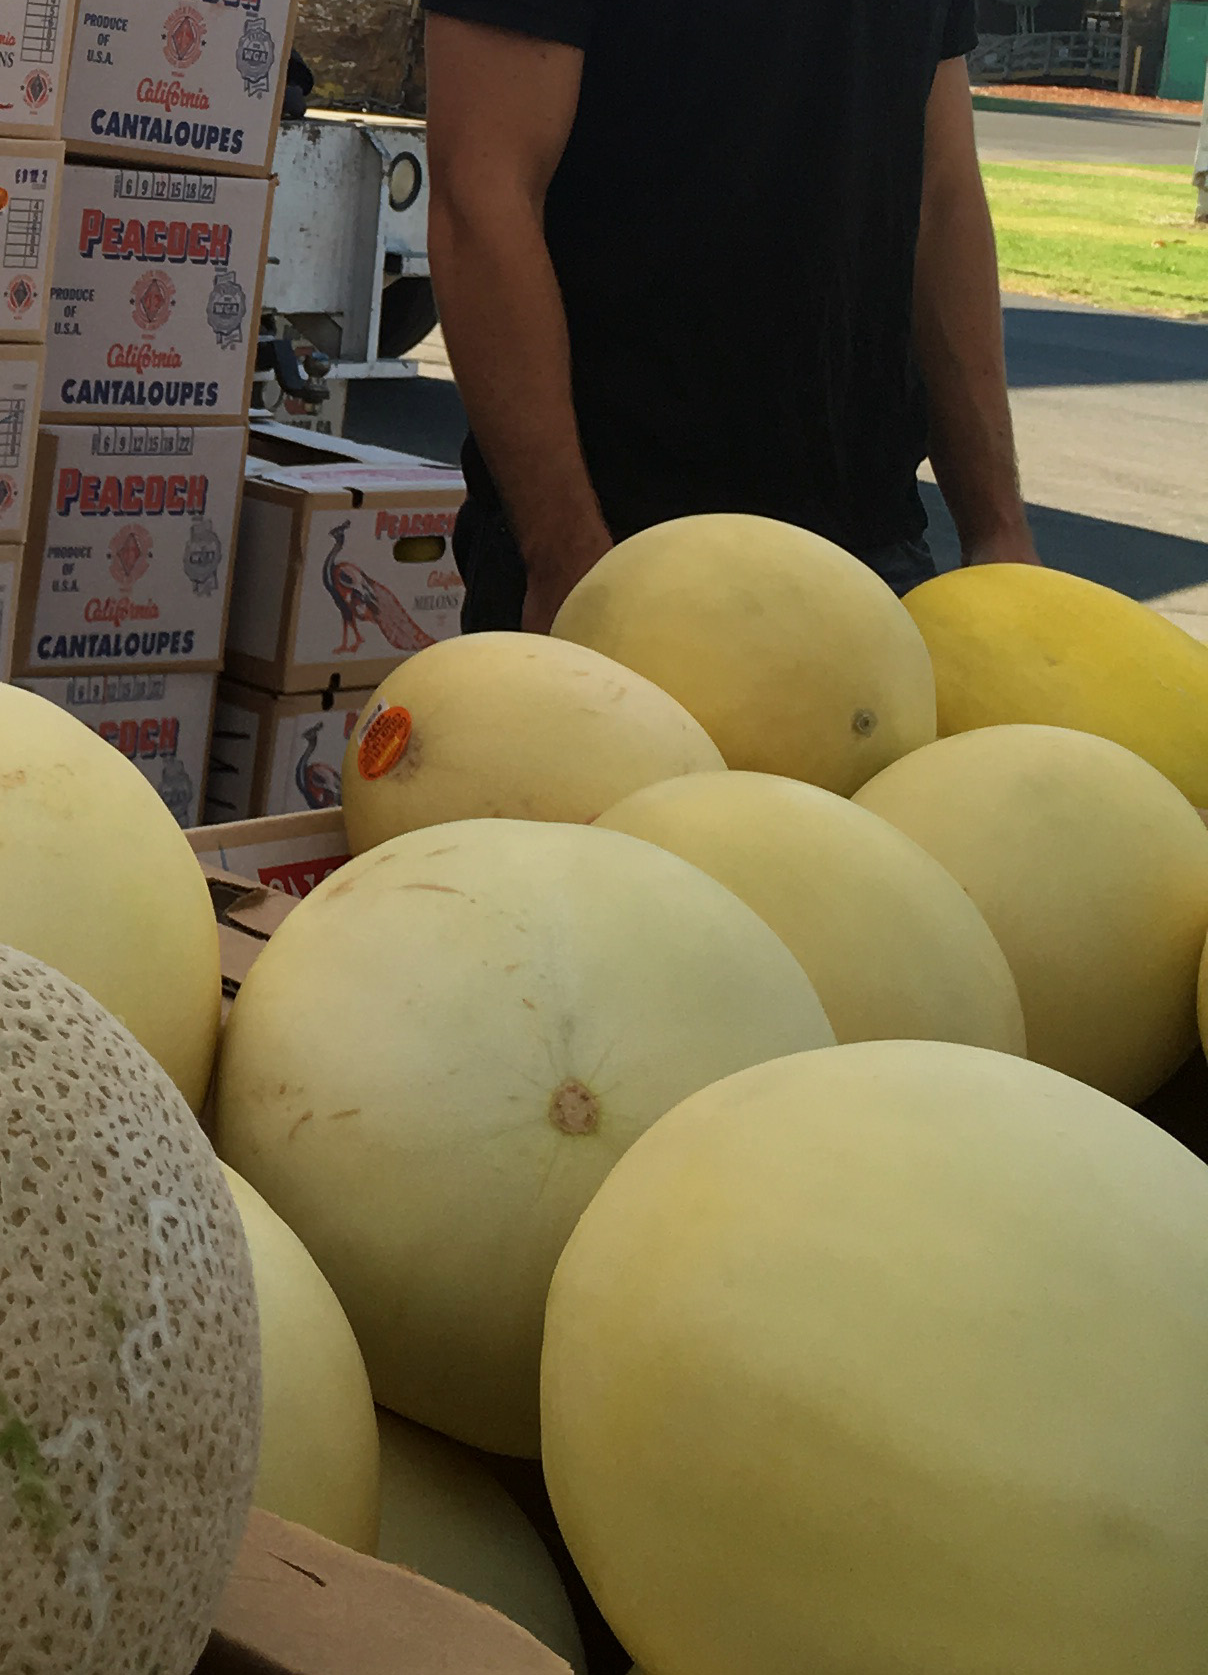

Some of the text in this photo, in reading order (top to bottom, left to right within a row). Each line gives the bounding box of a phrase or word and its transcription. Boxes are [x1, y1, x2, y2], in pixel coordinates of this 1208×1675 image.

[84, 12, 128, 32] PRODUCE
[97, 33, 110, 46] OF
[137, 78, 210, 112] California
[91, 109, 244, 154] CANTALOUPES
[125, 179, 133, 195] 6
[141, 180, 148, 196] 9
[155, 181, 165, 197] 12
[171, 182, 181, 198] 15
[186, 183, 196, 199] 18
[200, 184, 213, 200] 22
[79, 208, 232, 266] PEACOCK
[50, 288, 95, 301] PRODUCE
[64, 306, 77, 317] OF
[107, 343, 182, 374] California
[61, 379, 219, 406] CANTALOUPES
[103, 437, 110, 451] 6
[119, 437, 126, 451] 9
[133, 437, 142, 451] 12
[149, 437, 158, 451] 15
[56, 468, 208, 516] PEACOCK
[84, 596, 160, 627] California
[37, 630, 194, 660] CANTALOUPES
